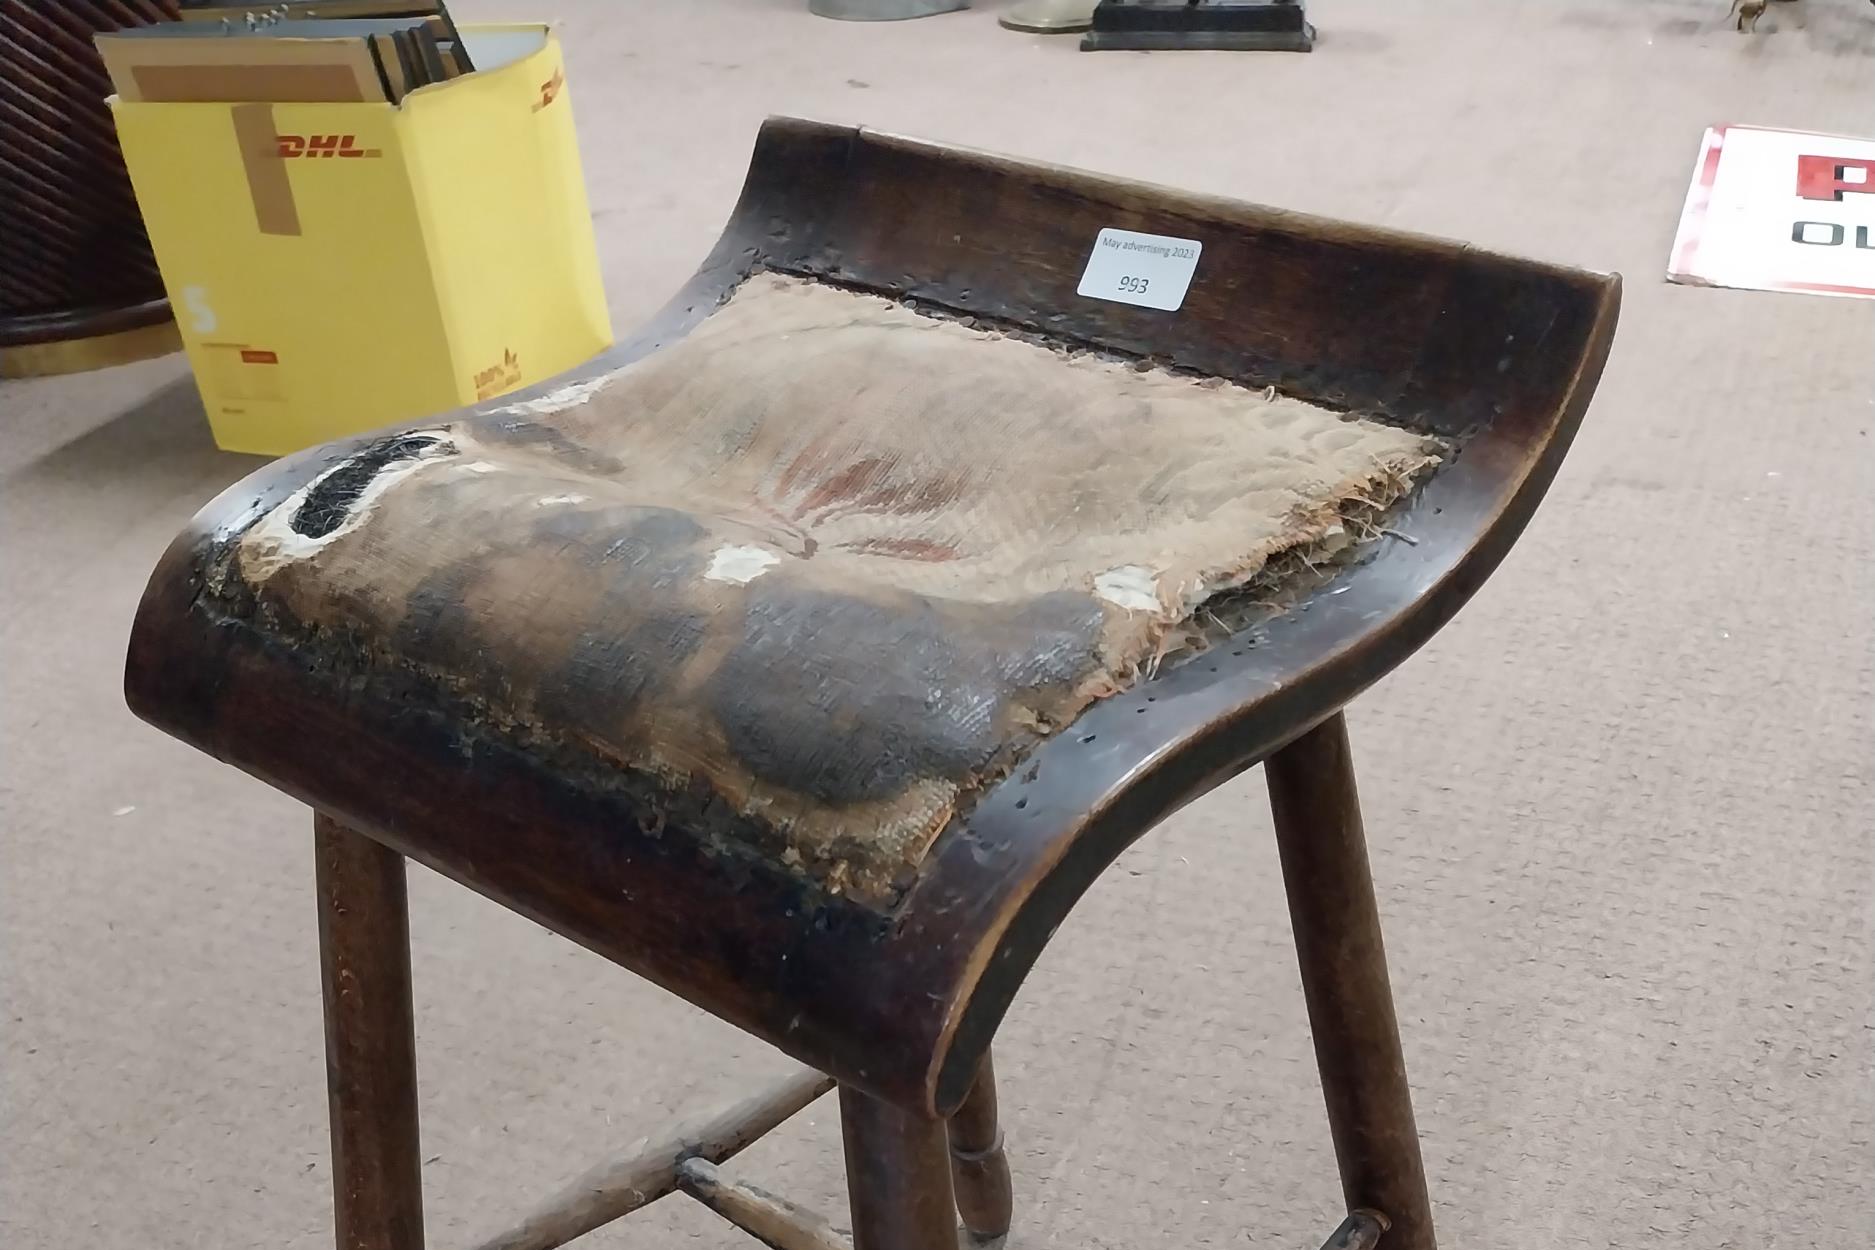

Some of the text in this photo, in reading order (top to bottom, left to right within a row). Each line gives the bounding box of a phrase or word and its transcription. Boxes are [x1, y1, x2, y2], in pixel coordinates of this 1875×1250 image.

[275, 135, 365, 158] DHL
[1103, 237, 1195, 259] May advertising 2023
[1118, 275, 1149, 294] 993
